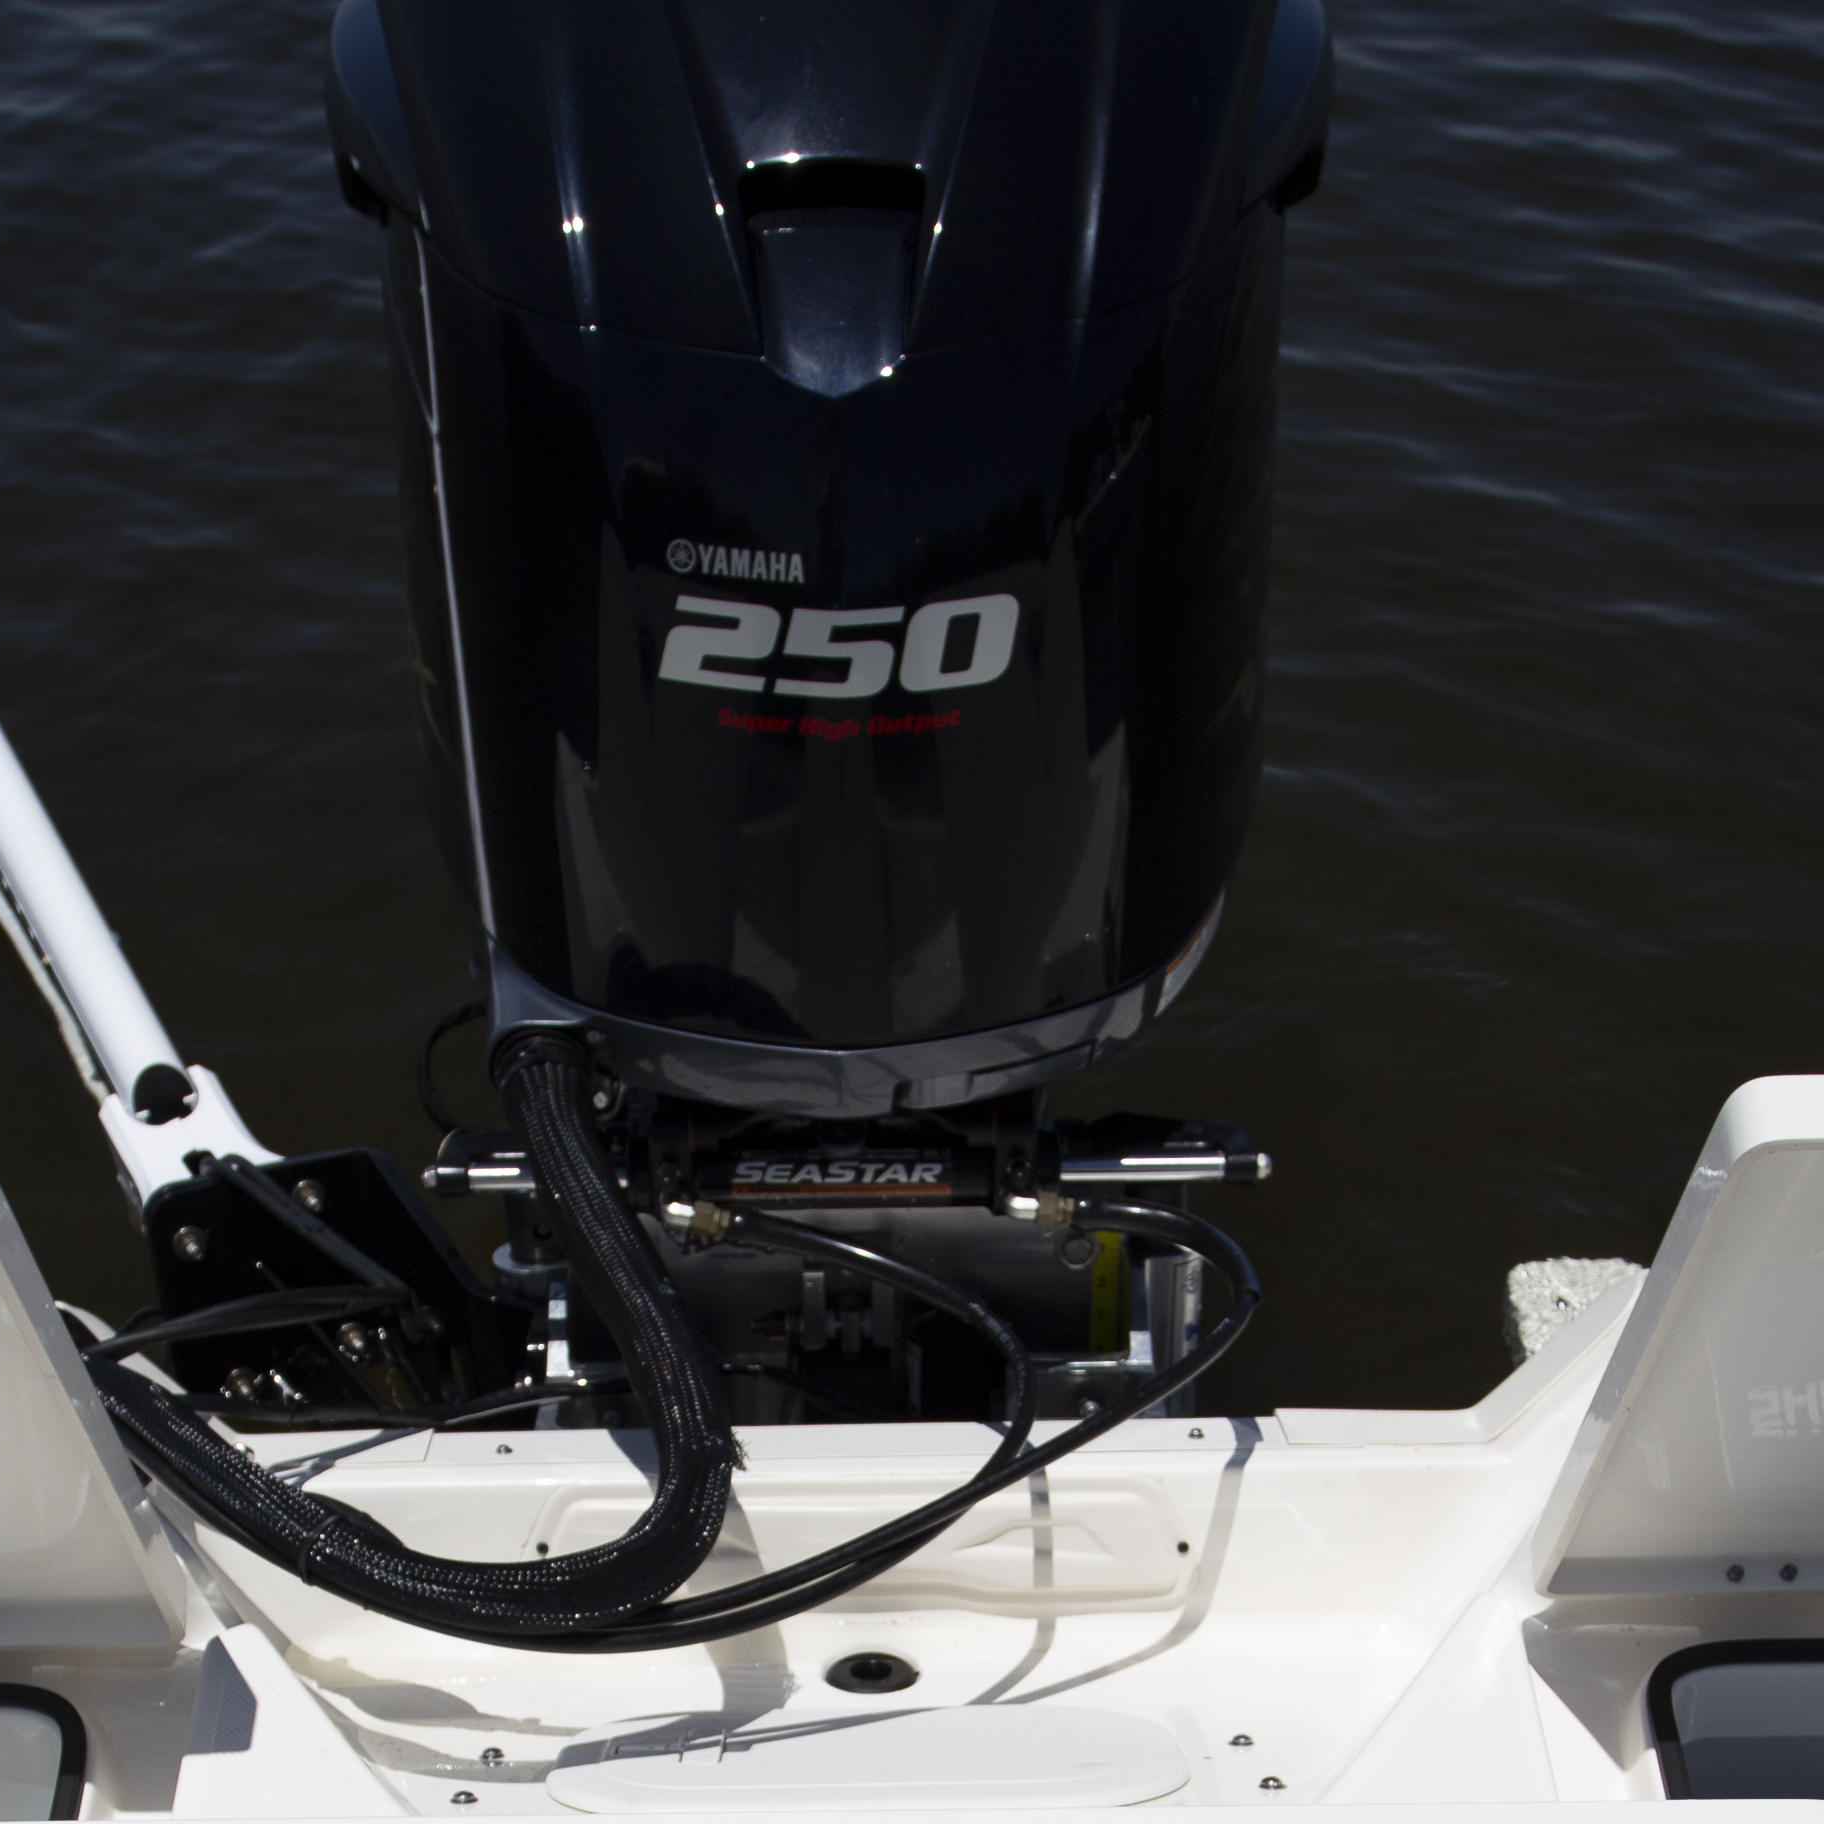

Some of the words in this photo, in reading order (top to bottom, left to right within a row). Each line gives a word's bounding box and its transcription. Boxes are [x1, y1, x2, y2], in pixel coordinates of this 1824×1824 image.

[697, 543, 806, 584] YAMAHA
[657, 592, 1021, 699] 250
[716, 706, 794, 733] Super
[797, 715, 861, 741] High
[866, 708, 962, 736] Output
